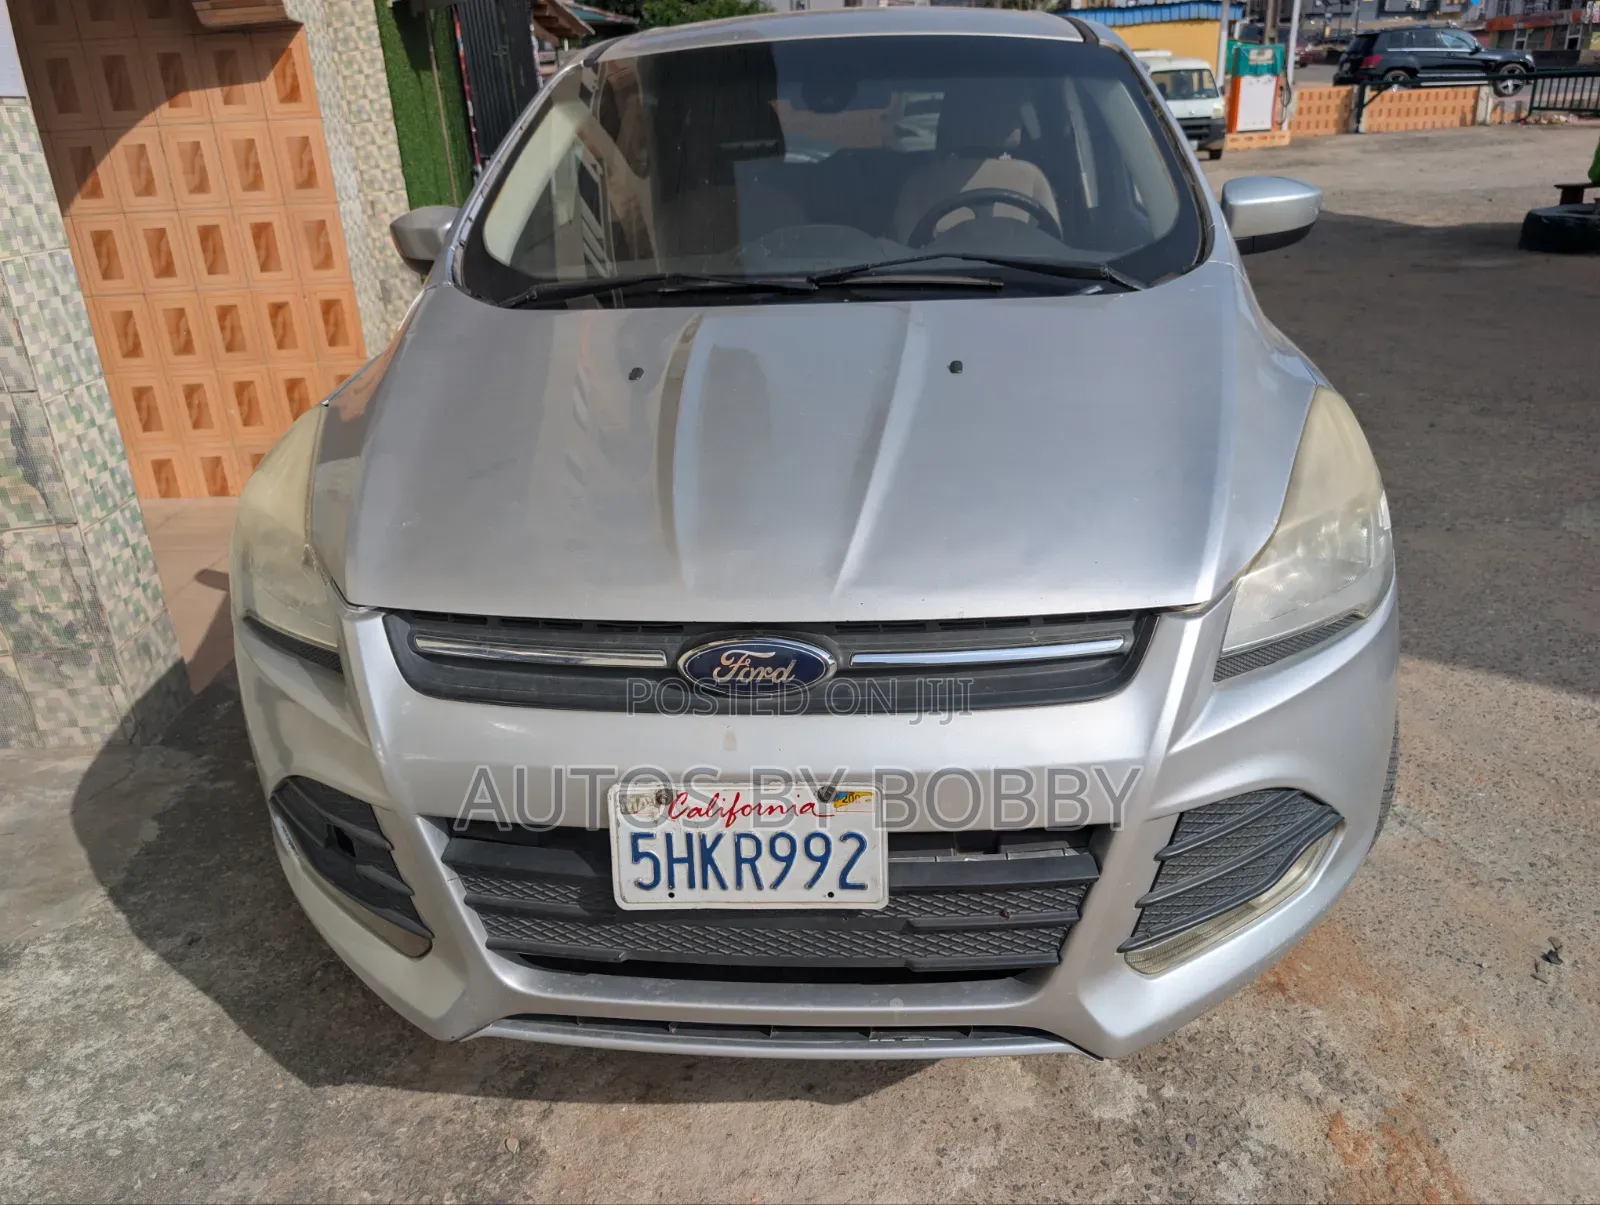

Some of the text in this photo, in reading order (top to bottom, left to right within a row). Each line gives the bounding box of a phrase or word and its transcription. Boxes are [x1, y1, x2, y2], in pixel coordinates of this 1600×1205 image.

[712, 650, 796, 684] Ford
[667, 791, 835, 828] California
[630, 831, 869, 891] 5HKR992
